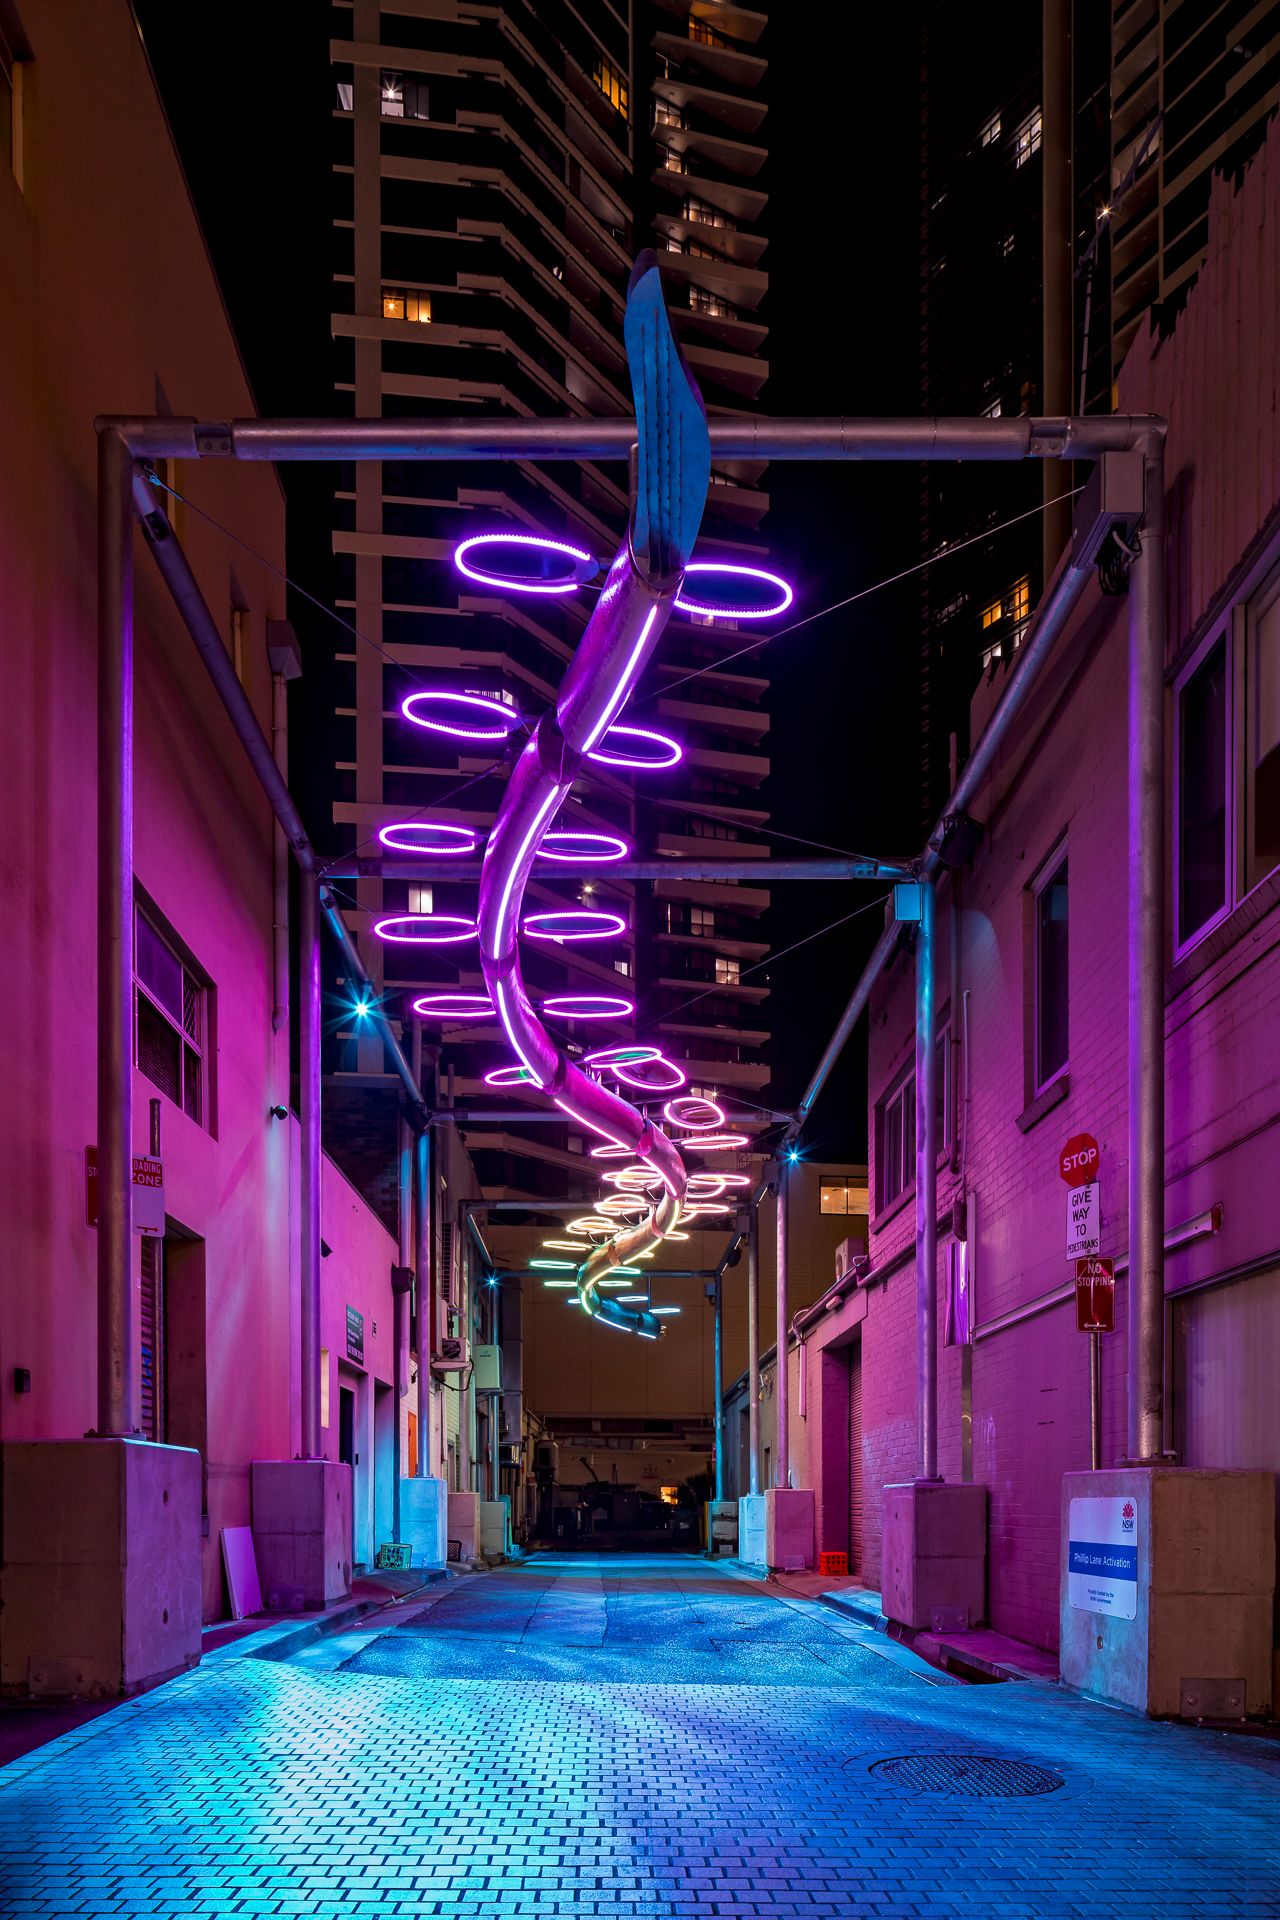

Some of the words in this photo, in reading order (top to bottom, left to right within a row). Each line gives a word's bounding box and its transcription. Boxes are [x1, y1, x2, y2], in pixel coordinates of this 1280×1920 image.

[1063, 1148, 1097, 1171] STOP
[131, 1161, 161, 1174] OADING
[131, 1173, 162, 1187] ZONE
[1072, 1191, 1092, 1207] GIVE
[1073, 1207, 1090, 1222] WAY
[1076, 1223, 1087, 1237] TO
[1068, 1239, 1098, 1253] PEDESTRIANS
[1088, 1263, 1102, 1274] NO
[1122, 1520, 1133, 1529] NSW
[1075, 1553, 1089, 1565] Phillip
[1090, 1555, 1102, 1565] Lane
[1103, 1556, 1130, 1568] Activation
